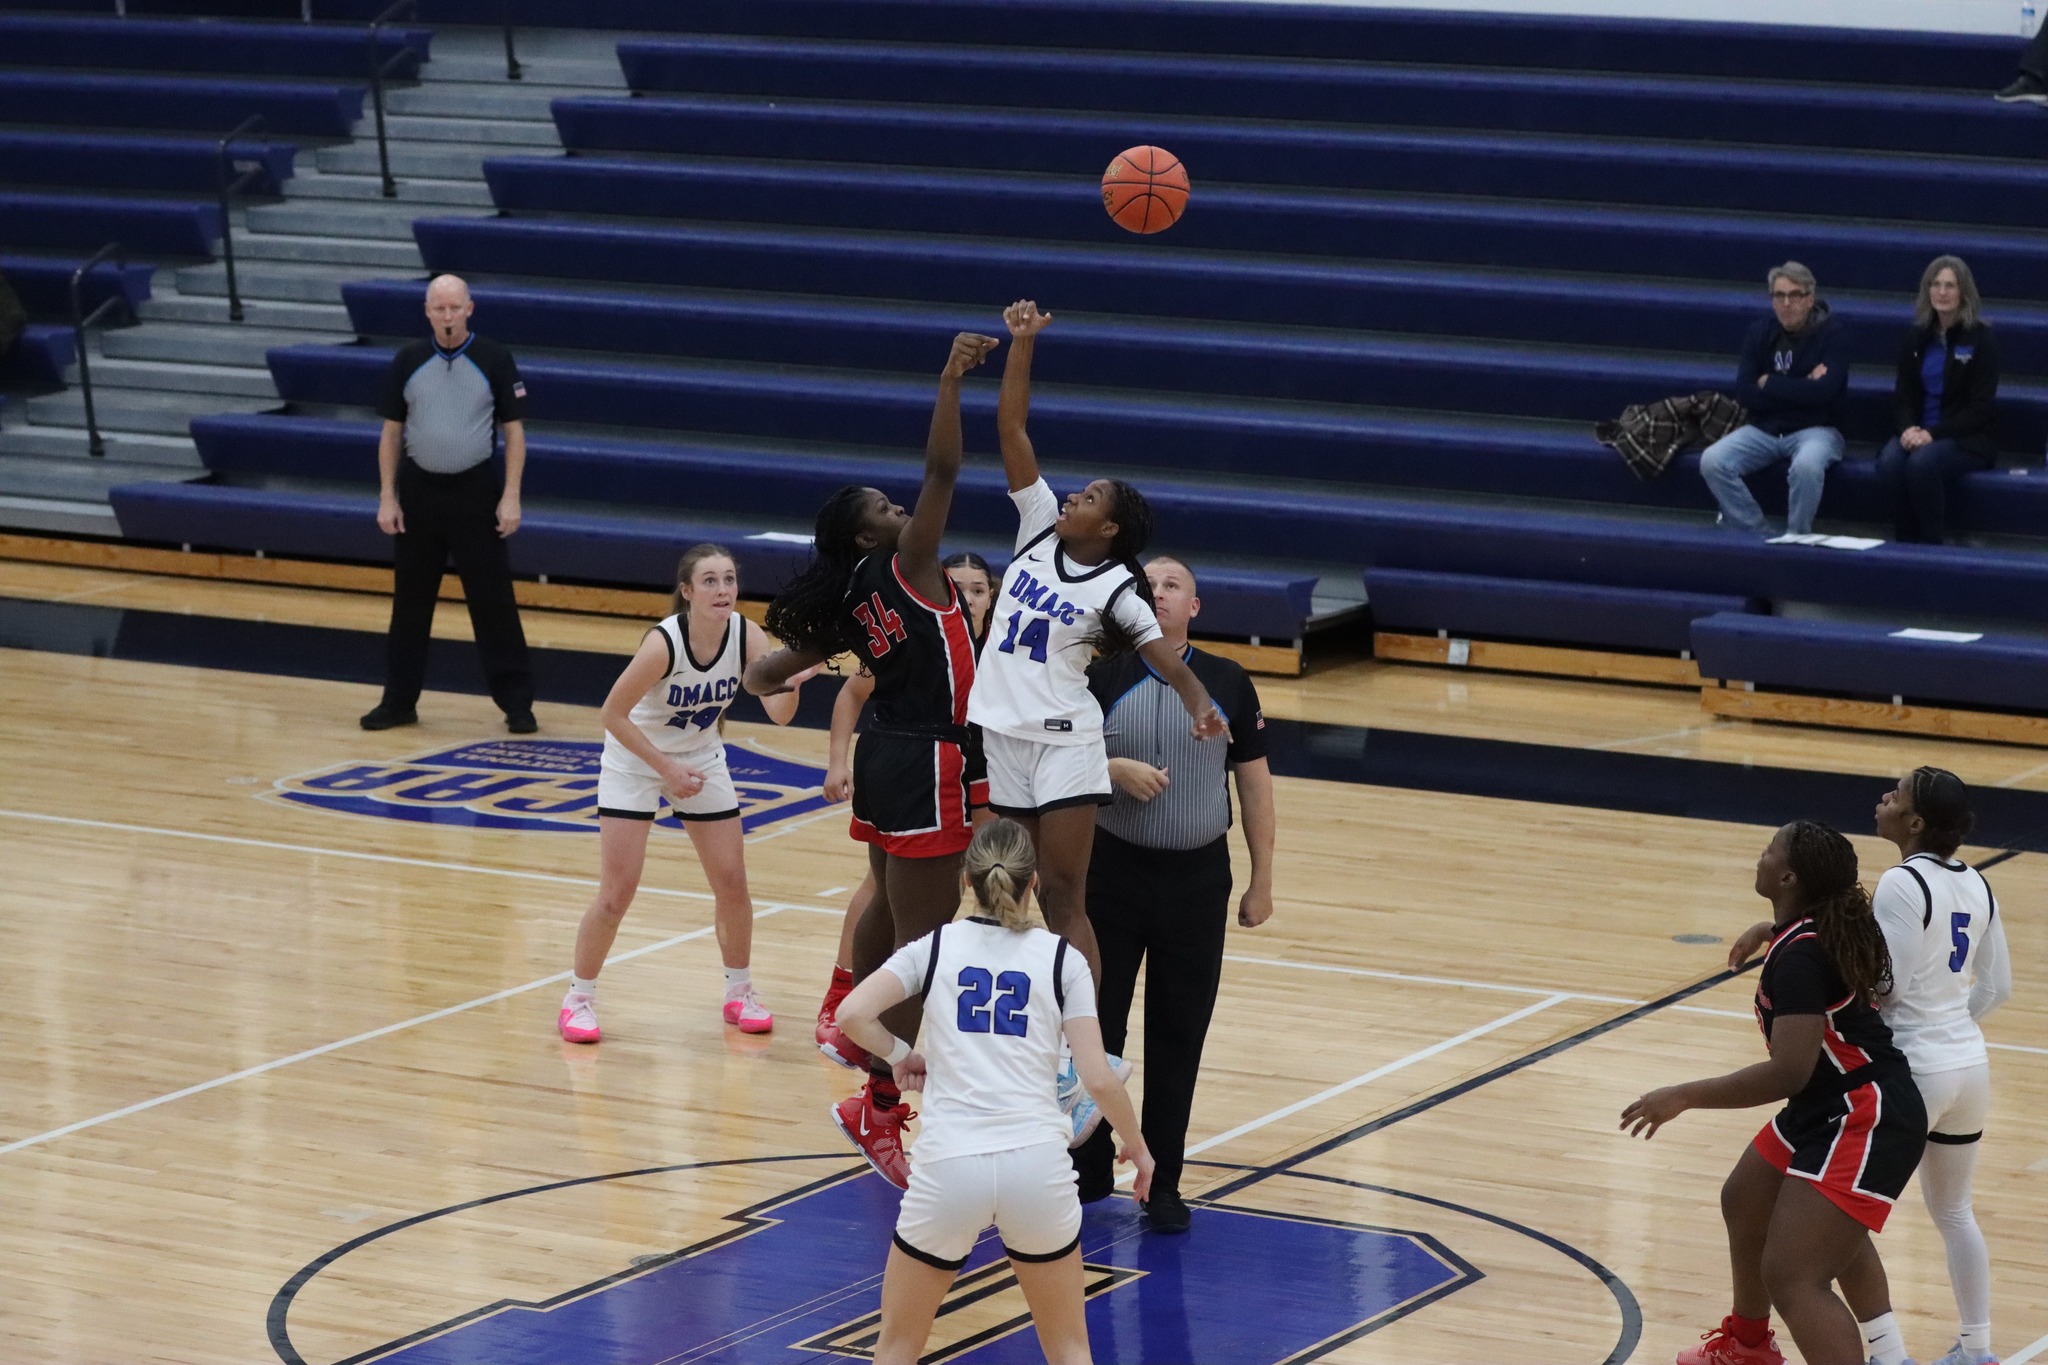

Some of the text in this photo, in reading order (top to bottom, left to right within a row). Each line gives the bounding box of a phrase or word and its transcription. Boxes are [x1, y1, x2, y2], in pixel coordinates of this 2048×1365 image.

[853, 591, 907, 659] 34
[1009, 569, 1084, 626] DMAC
[998, 610, 1050, 664] 14
[667, 677, 738, 707] DMACC
[1949, 912, 1971, 973] 5
[957, 966, 1032, 1037] 22
